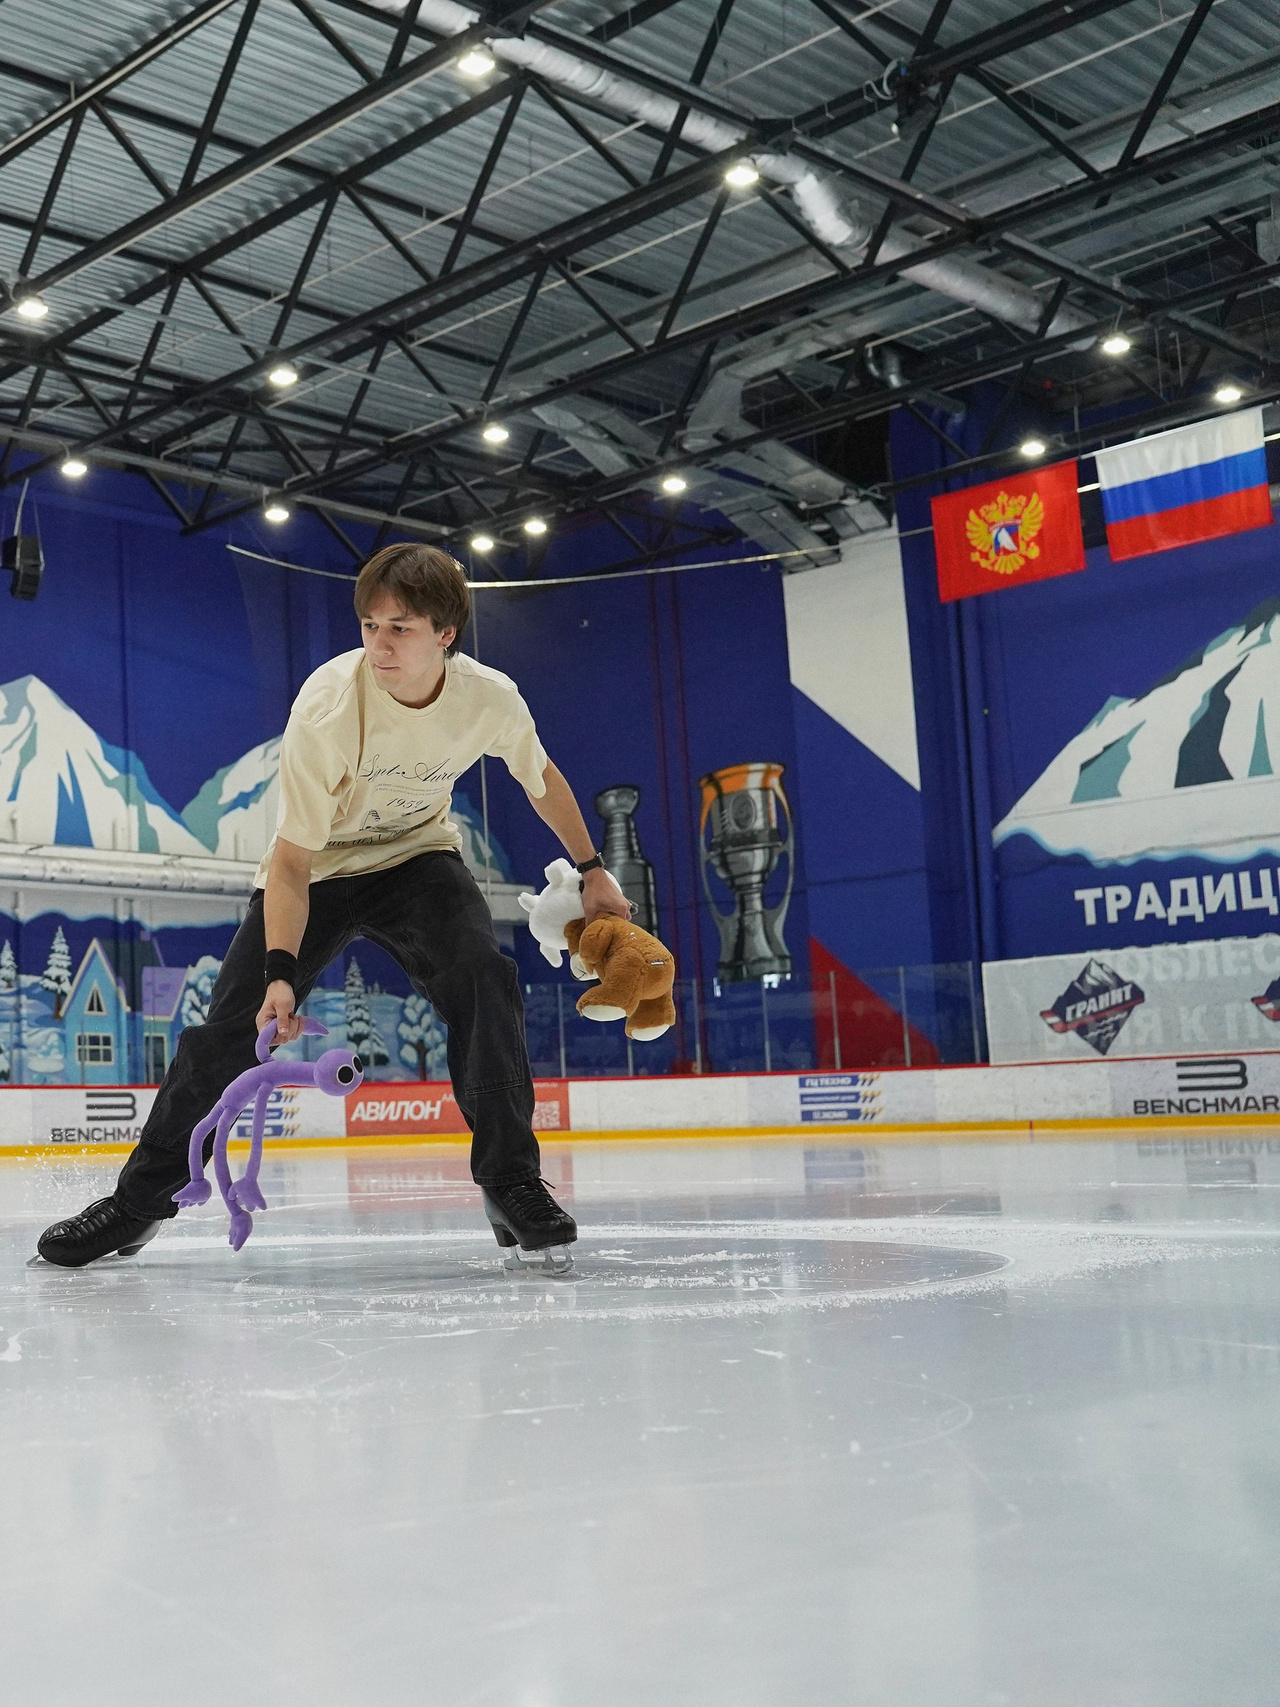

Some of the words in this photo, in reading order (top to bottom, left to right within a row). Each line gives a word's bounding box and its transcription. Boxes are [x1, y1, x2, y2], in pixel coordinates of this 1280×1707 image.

[1074, 867, 1280, 926] ТРАДИЦ
[1065, 983, 1133, 1022] ГРАНИТ
[351, 1100, 442, 1122] АВИЛОН
[1133, 1095, 1280, 1115] BENCHMAR
[51, 1127, 142, 1143] BENCHMA
